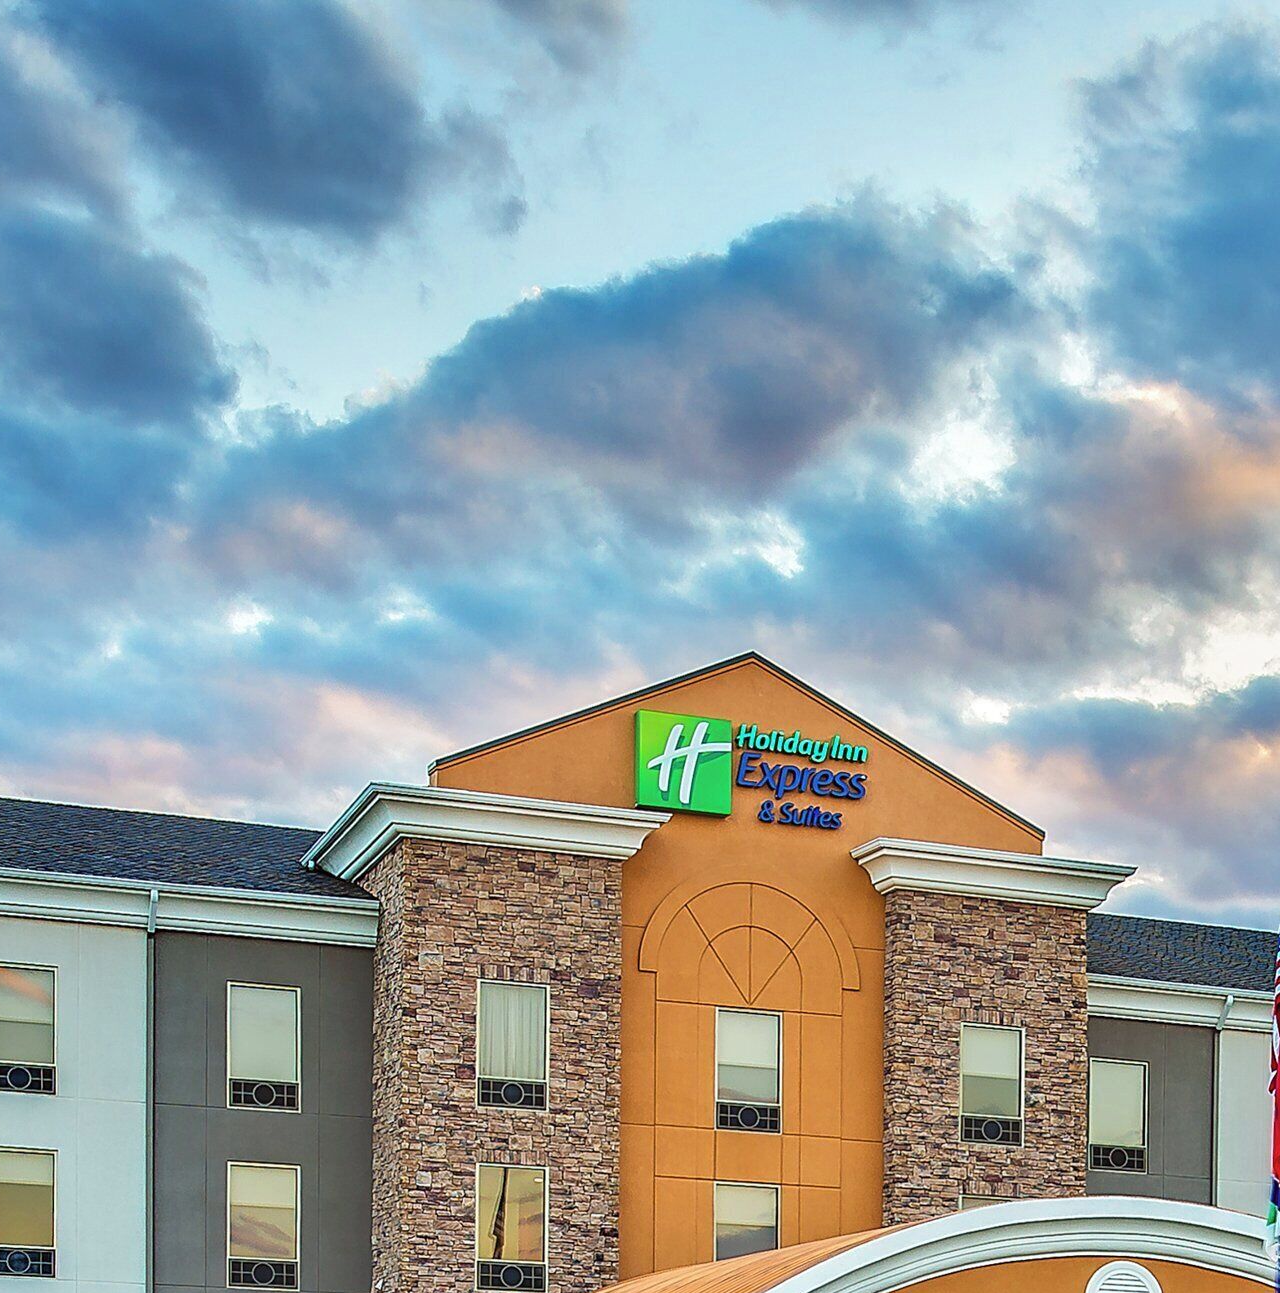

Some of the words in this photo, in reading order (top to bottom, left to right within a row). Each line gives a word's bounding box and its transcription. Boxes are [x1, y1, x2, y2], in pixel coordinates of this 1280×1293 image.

[736, 723, 829, 763] Holiday
[830, 734, 869, 763] Inn
[735, 751, 868, 800] Express
[757, 799, 775, 823] &
[778, 801, 843, 830] Suites
